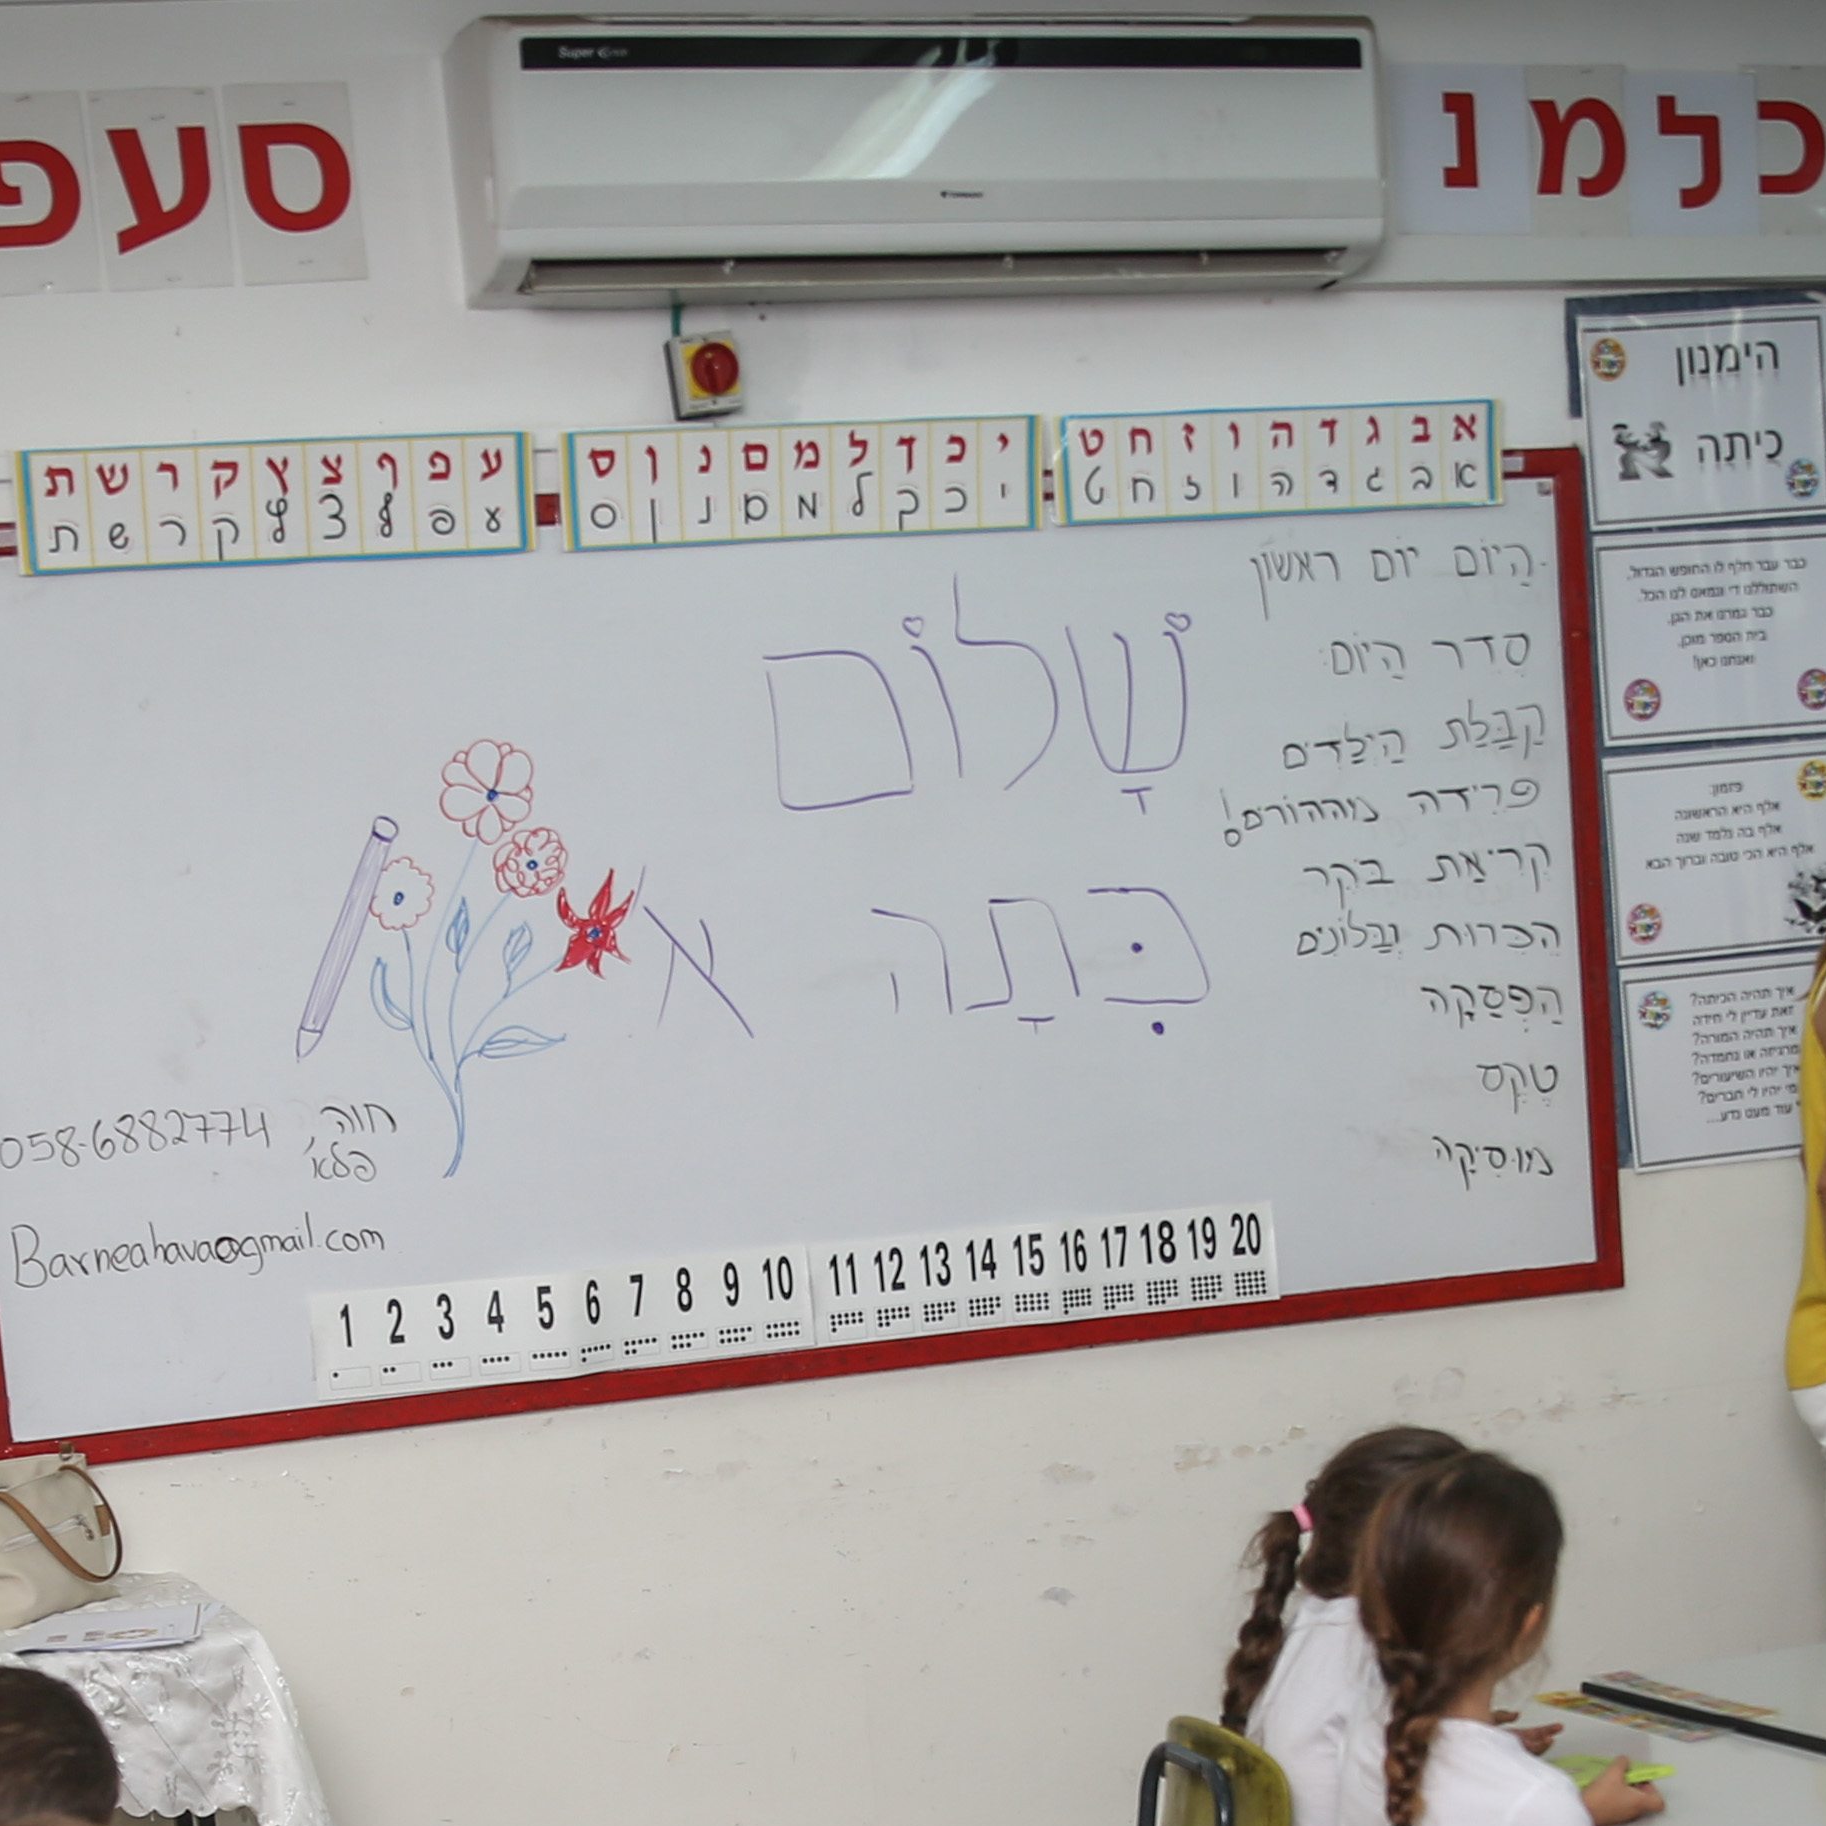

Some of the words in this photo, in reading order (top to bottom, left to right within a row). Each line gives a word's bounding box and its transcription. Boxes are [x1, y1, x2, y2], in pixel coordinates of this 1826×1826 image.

[1677, 341, 1779, 386] הימנון
[1699, 430, 1783, 463] כיתה
[341, 1304, 352, 1347] 1
[388, 1299, 405, 1344] 2
[437, 1294, 454, 1339] 3
[488, 1291, 504, 1333] 4
[537, 1286, 554, 1329] 5
[586, 1280, 600, 1324] 6
[630, 1274, 643, 1316] 7
[677, 1268, 692, 1312] 8
[724, 1262, 739, 1306] 9
[763, 1256, 793, 1300] 10
